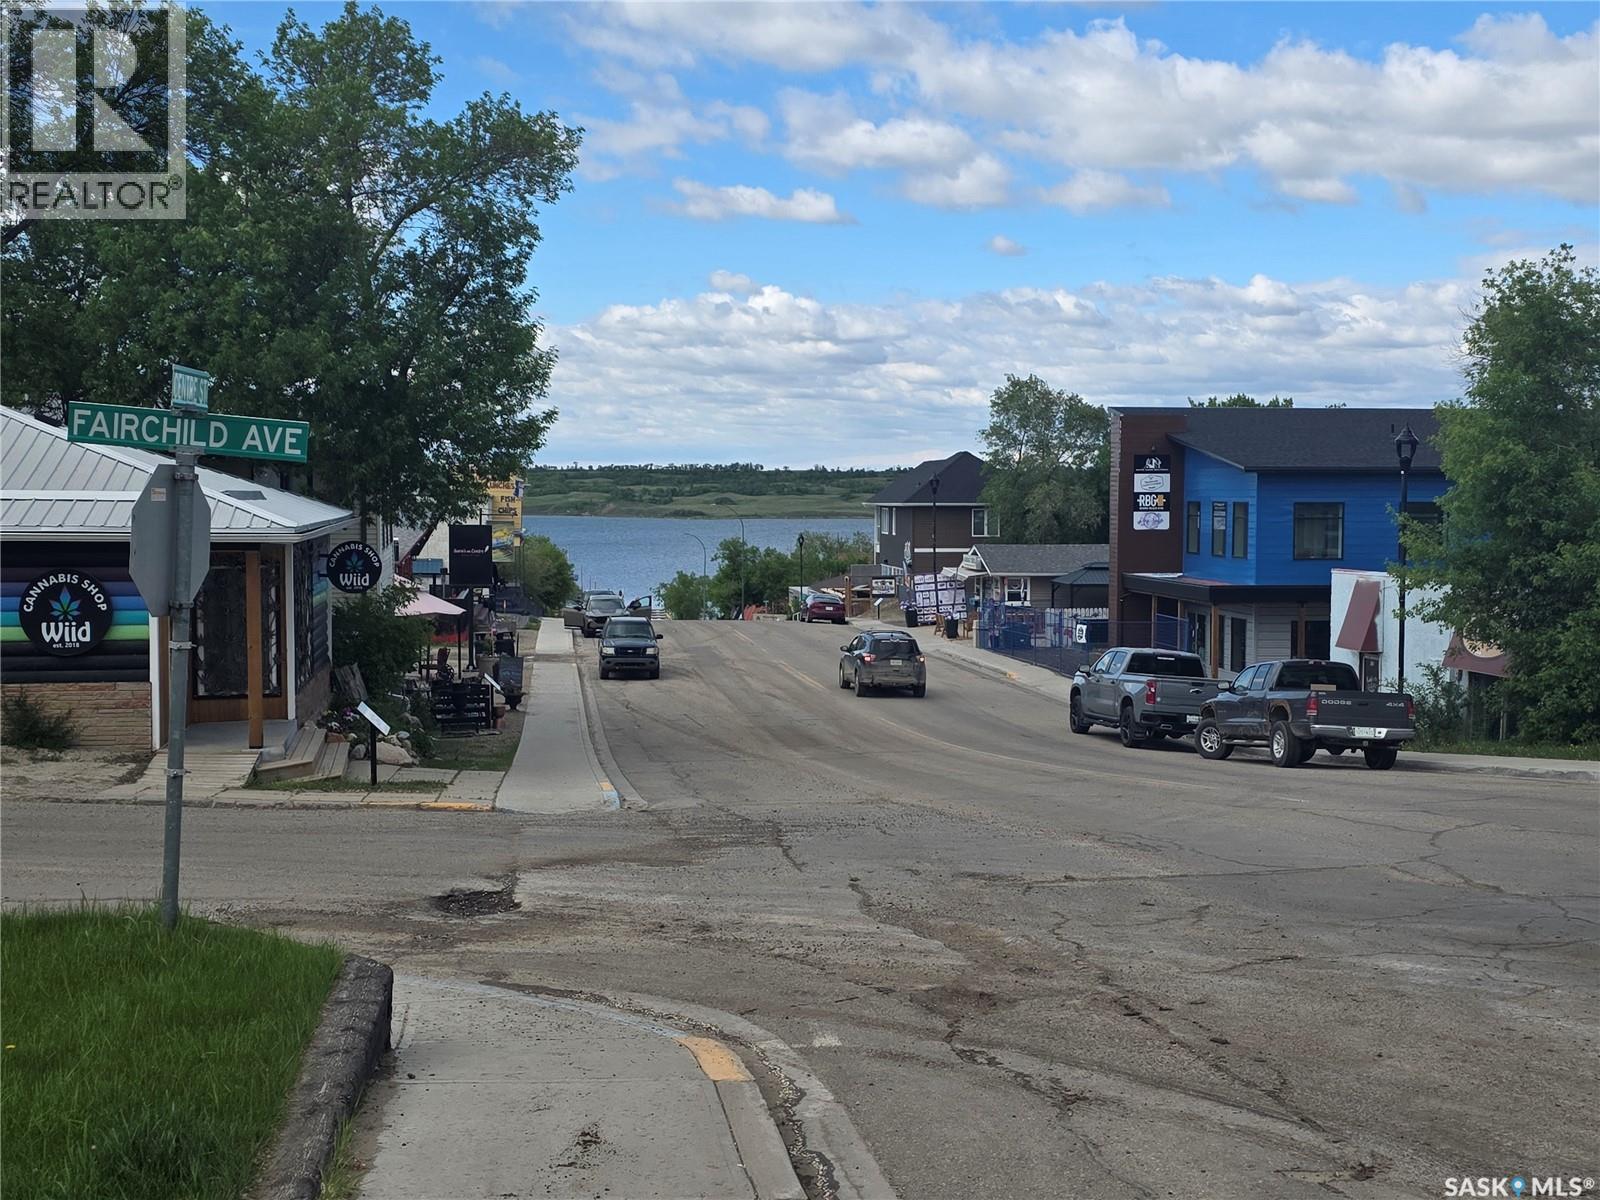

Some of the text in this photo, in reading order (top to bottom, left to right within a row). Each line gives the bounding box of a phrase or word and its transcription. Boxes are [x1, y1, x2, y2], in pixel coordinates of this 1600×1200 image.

[73, 409, 302, 454] FAIRCHILD AVE
[487, 480, 515, 489] UNCHES
[1139, 494, 1157, 507] RBG
[329, 543, 380, 568] CANNABIS SHOP
[340, 573, 369, 586] Wiid
[23, 573, 107, 612] CANNABIS SHOP
[41, 621, 91, 643] Wiid
